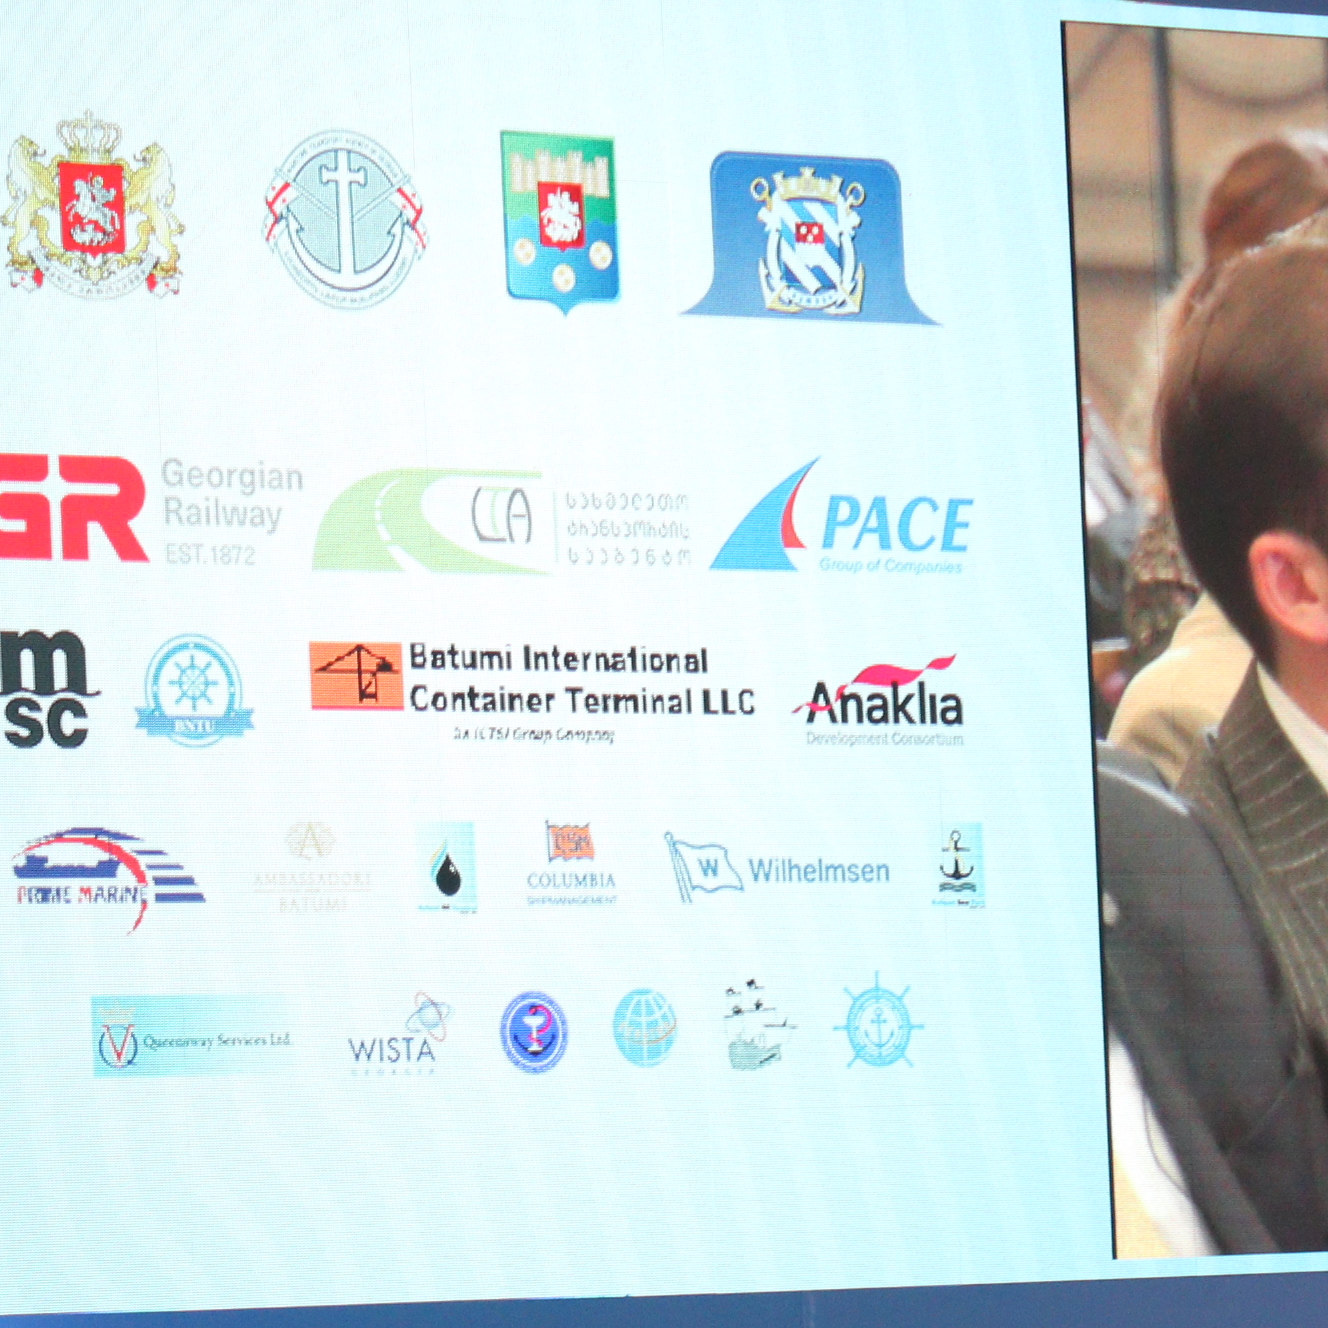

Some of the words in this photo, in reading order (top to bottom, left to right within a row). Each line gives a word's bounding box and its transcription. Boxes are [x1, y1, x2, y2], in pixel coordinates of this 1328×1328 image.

[161, 457, 304, 497] Georgian
[165, 496, 283, 535] Railway
[822, 494, 975, 553] PACE
[819, 556, 863, 574] Group
[866, 558, 881, 572] of
[884, 557, 963, 576] Companies
[409, 642, 513, 671] Batumi
[523, 643, 709, 674] International
[409, 684, 556, 712] Container
[564, 686, 693, 714] Terminal
[701, 688, 756, 716] LLC
[806, 680, 964, 726] Anaklia
[513, 727, 553, 744] Group
[806, 730, 888, 748] Development
[891, 731, 964, 747] Consortium
[697, 857, 719, 877] W
[748, 858, 891, 883] Wilhelmsen
[526, 872, 616, 889] COLUMBIA
[78, 885, 148, 905] MARINE
[217, 1032, 267, 1047] Services
[347, 1037, 436, 1063] WISTA
